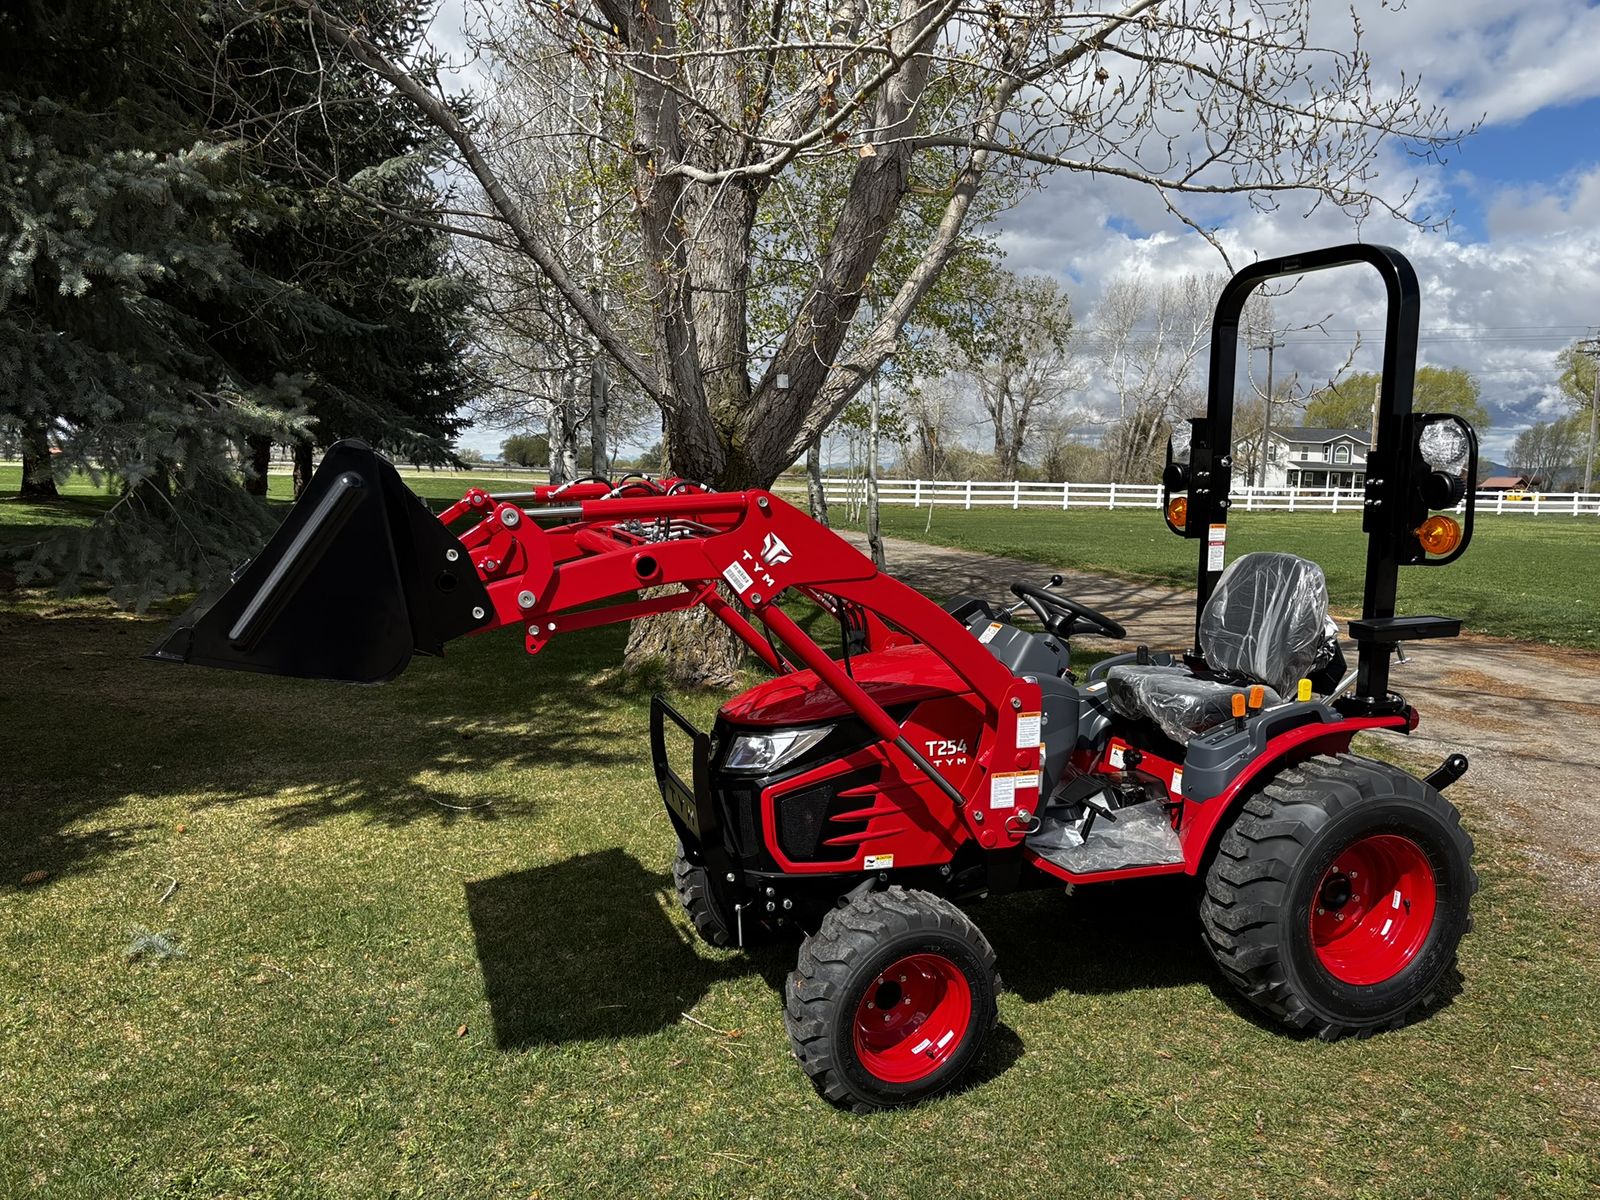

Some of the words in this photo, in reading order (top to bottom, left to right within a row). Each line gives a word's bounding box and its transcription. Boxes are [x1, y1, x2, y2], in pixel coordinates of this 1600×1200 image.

[742, 549, 775, 587] TYM
[925, 739, 967, 757] T254
[933, 757, 967, 767] TYM
